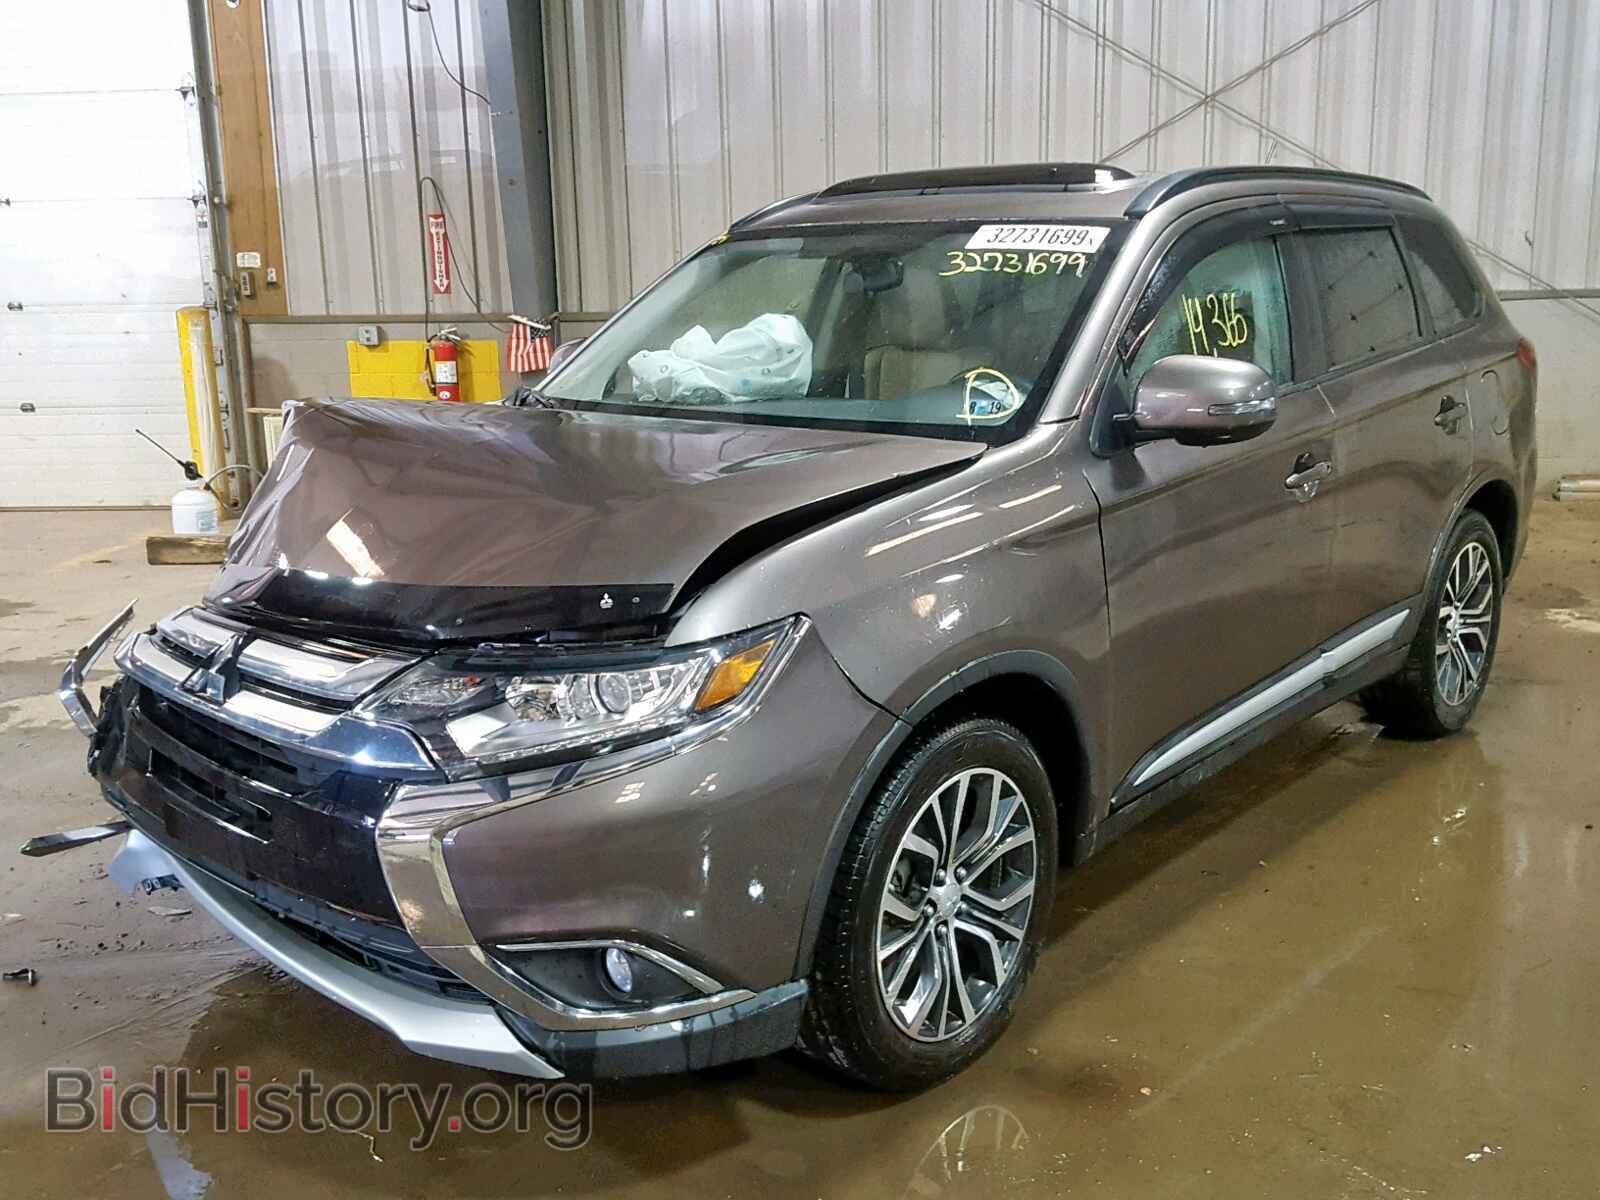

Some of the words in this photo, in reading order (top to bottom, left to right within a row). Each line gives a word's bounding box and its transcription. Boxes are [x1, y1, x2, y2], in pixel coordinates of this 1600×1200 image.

[987, 227, 1089, 246] 32731699
[938, 251, 1087, 278] 32731699
[990, 400, 1002, 415] 19
